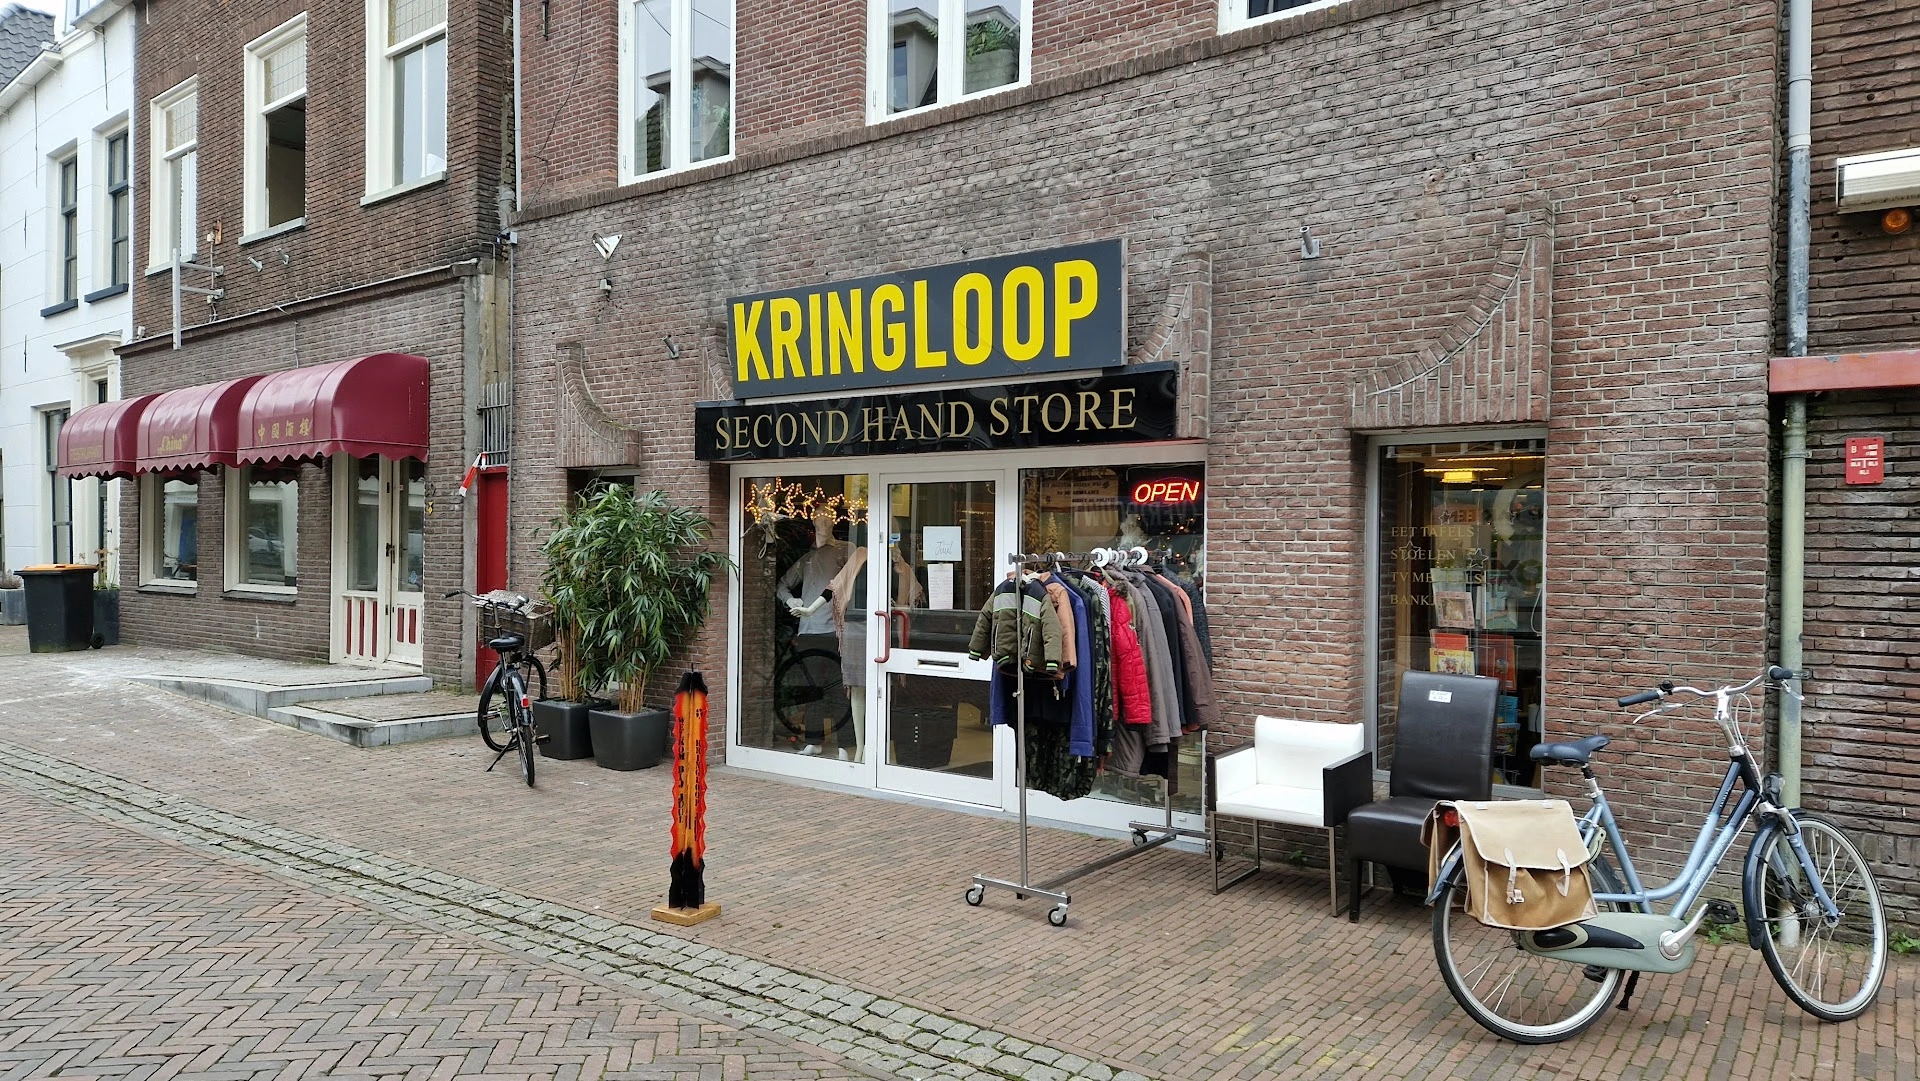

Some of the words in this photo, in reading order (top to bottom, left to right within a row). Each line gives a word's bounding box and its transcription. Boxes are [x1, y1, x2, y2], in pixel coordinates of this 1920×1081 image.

[733, 259, 1099, 382] KRINGLOOP
[715, 410, 849, 450] SECOND
[861, 400, 975, 442] HAND
[989, 388, 1138, 437] STORE
[1133, 481, 1200, 503] OPEN
[1391, 526, 1418, 537] EET
[1420, 526, 1475, 538] TAFELS
[1390, 549, 1457, 560] STOELEN
[1390, 571, 1407, 583] TV
[1412, 572, 1484, 584] MEELS
